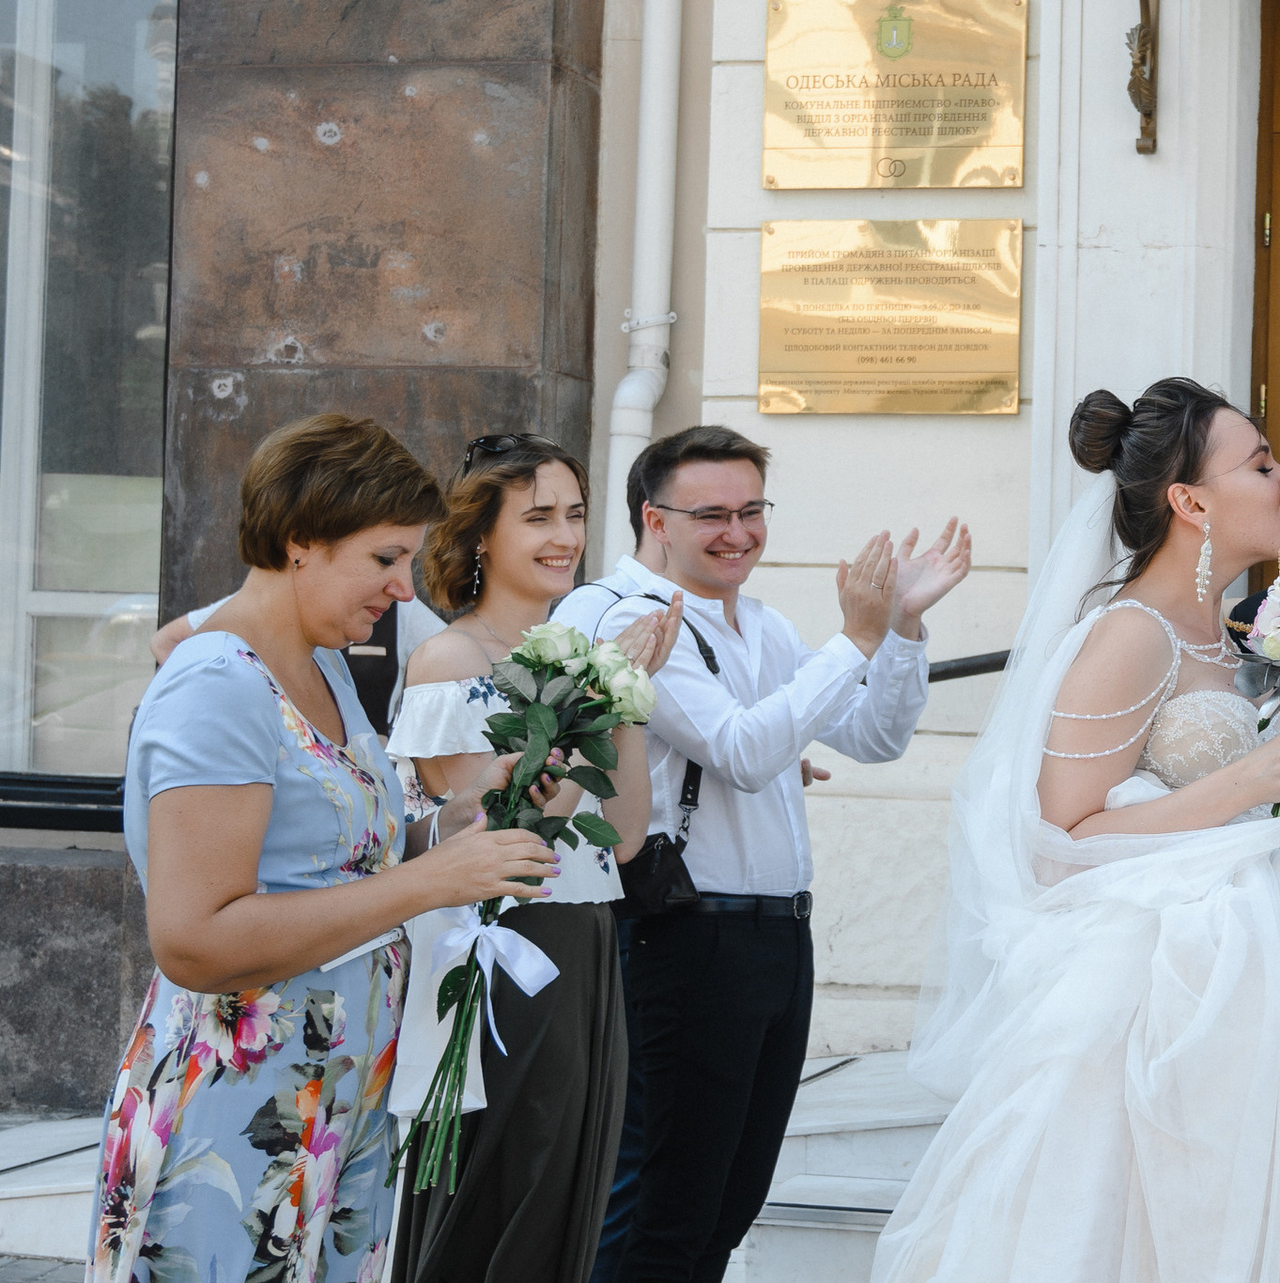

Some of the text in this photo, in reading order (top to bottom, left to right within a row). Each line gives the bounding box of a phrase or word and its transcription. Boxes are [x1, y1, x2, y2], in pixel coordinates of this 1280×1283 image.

[786, 73, 999, 91] ОДЕСЬКА МІСЬКА РАДА
[784, 98, 1000, 110] КОМУНАЛЬНЕ ПІДПРИЄМСТВО «ПРАВО»
[797, 112, 987, 124] ВІДДІЛ З ОРГАНІЗАЦІЇ ПРОВЕДЕННЯ
[804, 126, 978, 138] ДЕРЖАВНОЇ РЕЄСТРАЦІЇ ШЛЮБУ
[788, 250, 830, 259] ПРИЙОМ
[832, 250, 884, 259] ГРОМАДЯН
[887, 250, 893, 258] З
[937, 249, 996, 258] ОРГАНІЗАЦІЇ
[781, 262, 1002, 272] ПРОВЕДЕННЯ ДЕРЖАВНОЇ РЕЄСТРАЦІЇ ШЛЮБІВ
[812, 277, 848, 286] ПАЛАЦІ
[851, 277, 903, 286] ОДРУЖЕНЬ
[791, 327, 824, 335] СУБОТУ
[825, 327, 835, 335] ТА
[838, 327, 871, 335] НЕДІЛЮ
[898, 343, 935, 351] ТЕЛЕФОН
[857, 356, 878, 365] (098)
[880, 356, 893, 364] 461
